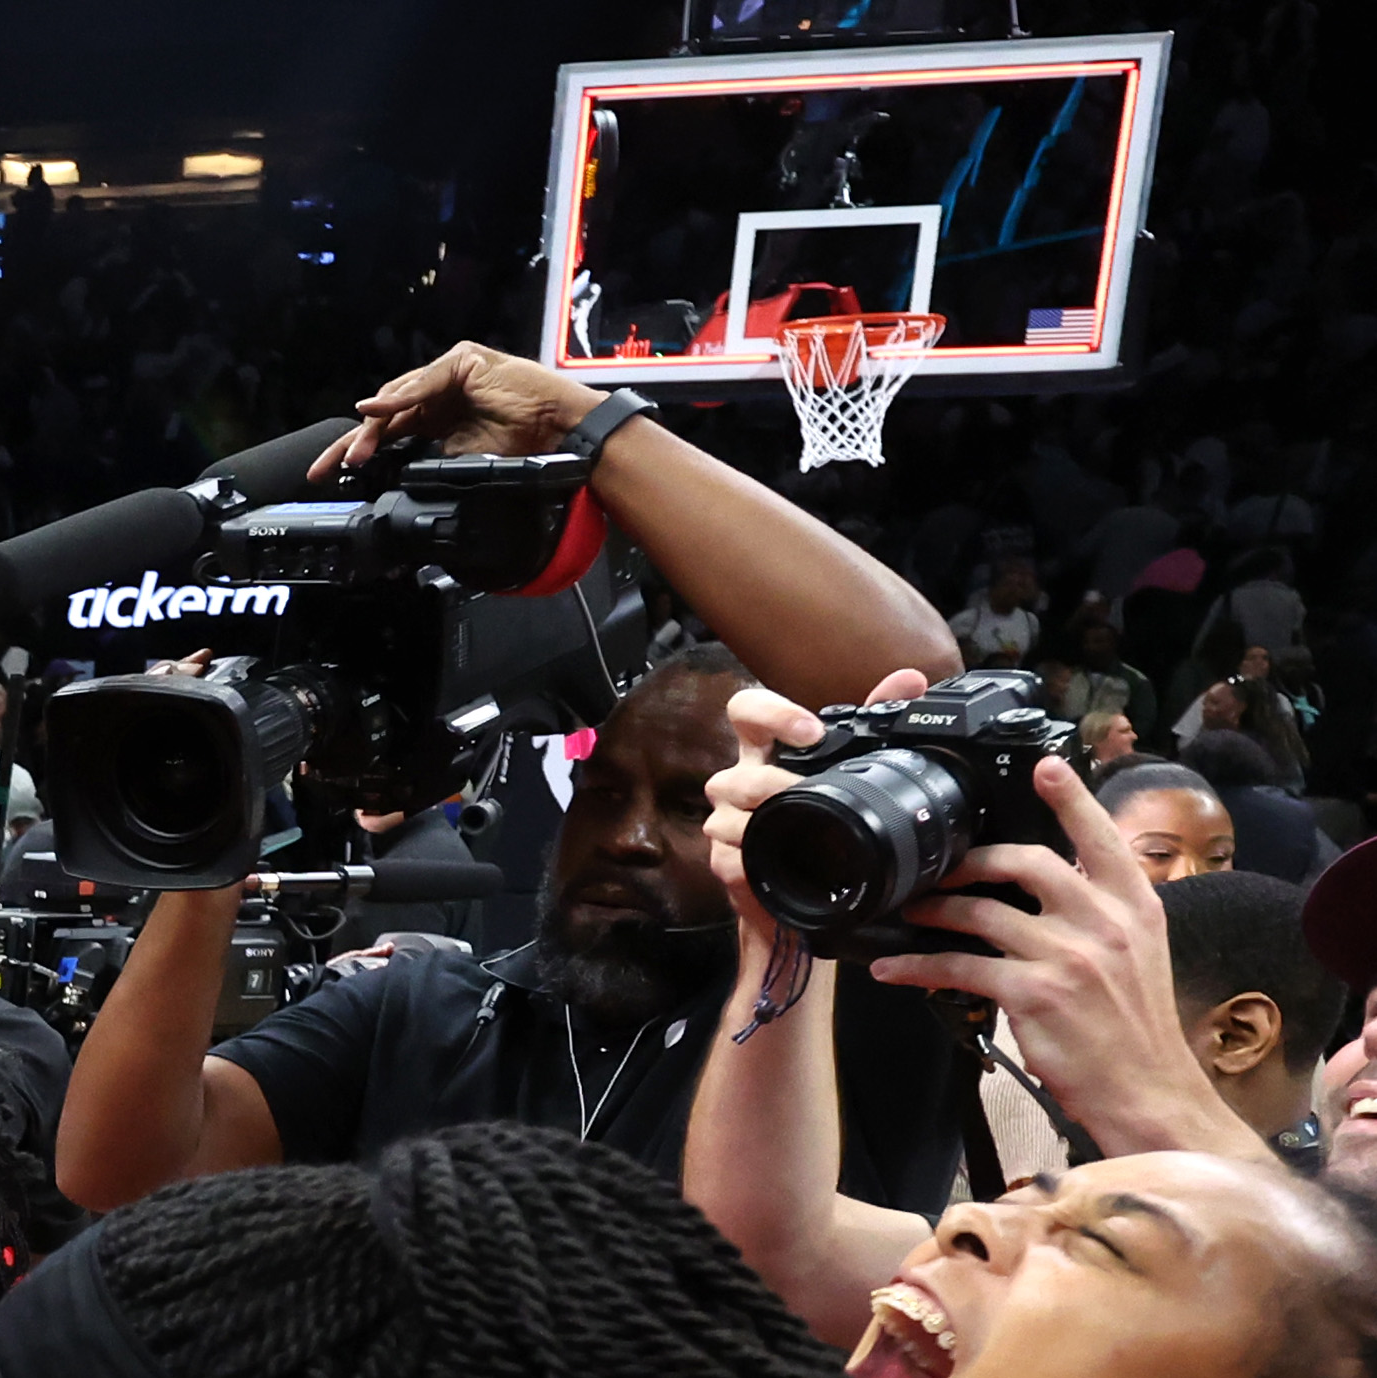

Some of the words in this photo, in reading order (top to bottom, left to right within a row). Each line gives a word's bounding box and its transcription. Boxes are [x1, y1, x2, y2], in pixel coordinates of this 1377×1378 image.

[248, 526, 288, 537] SONY
[907, 712, 958, 726] SONY
[245, 947, 275, 957] SONY
